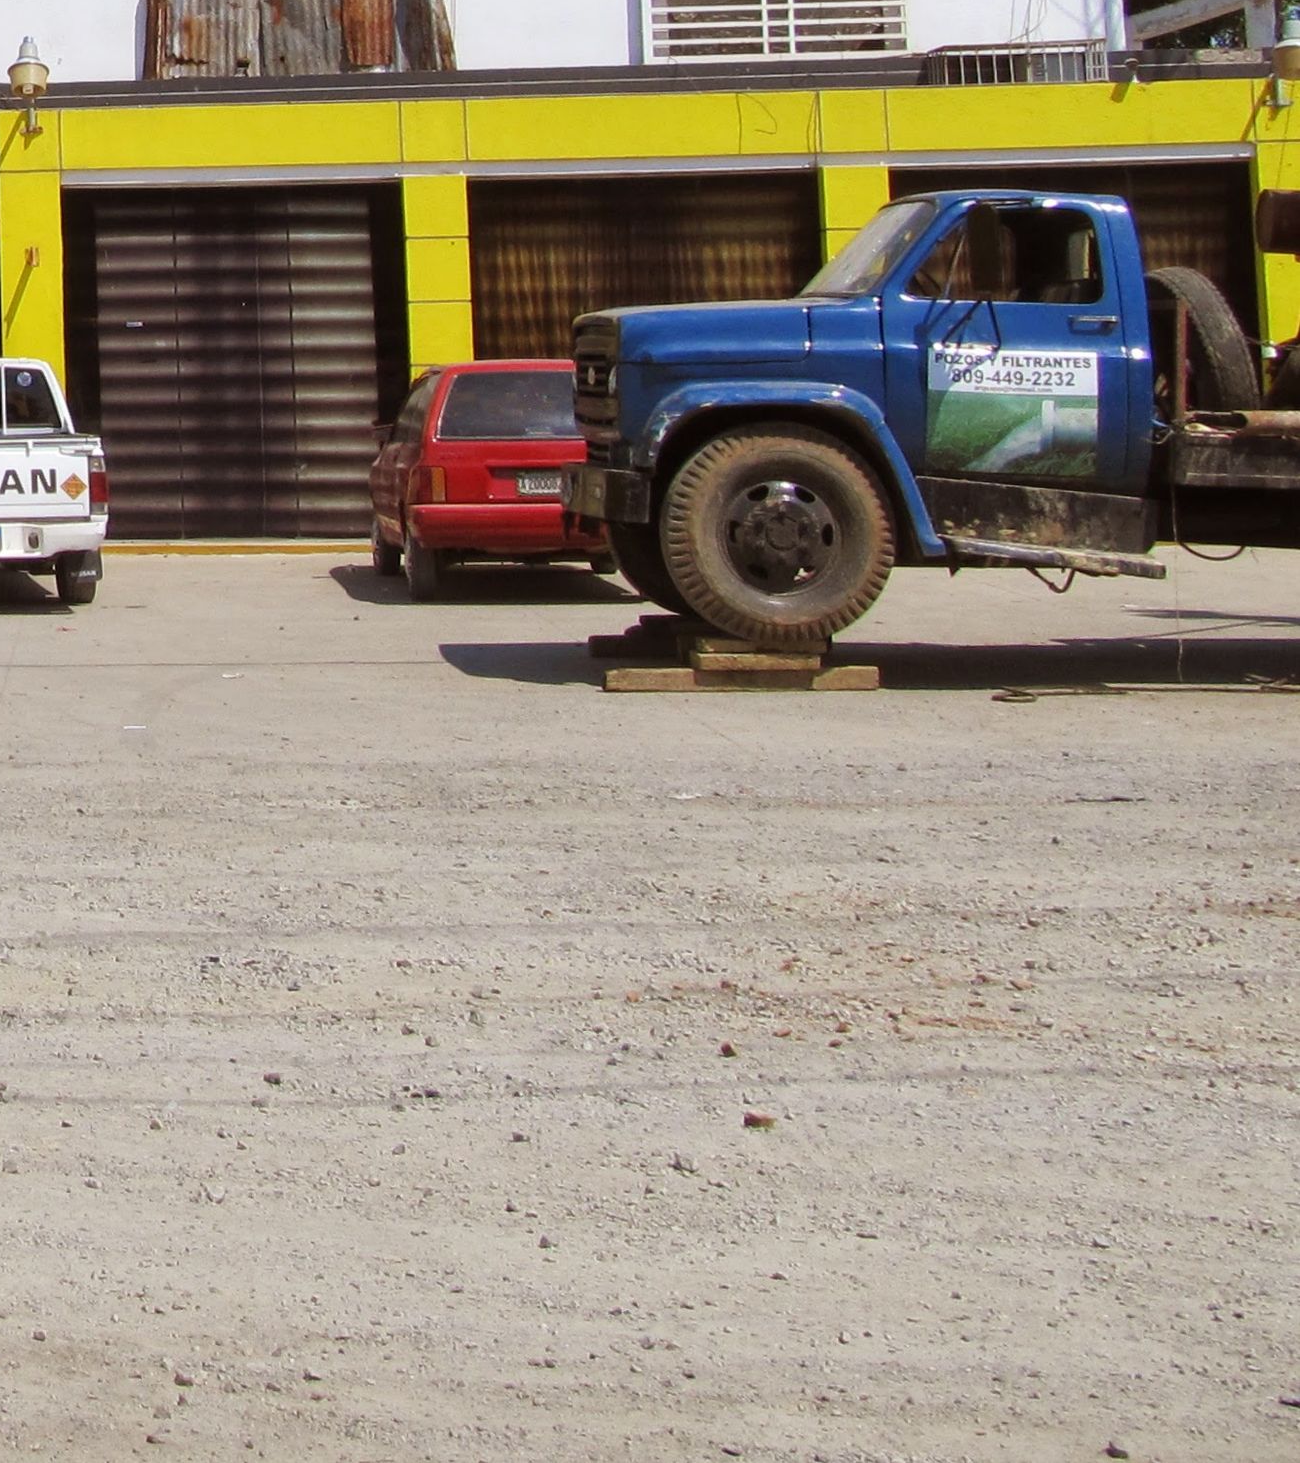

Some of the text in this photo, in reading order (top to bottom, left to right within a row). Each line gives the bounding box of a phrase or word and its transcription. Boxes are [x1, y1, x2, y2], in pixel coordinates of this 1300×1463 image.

[935, 353, 1092, 368] POZOS Y FILTRANTES
[951, 368, 1076, 387] 809-449-2232
